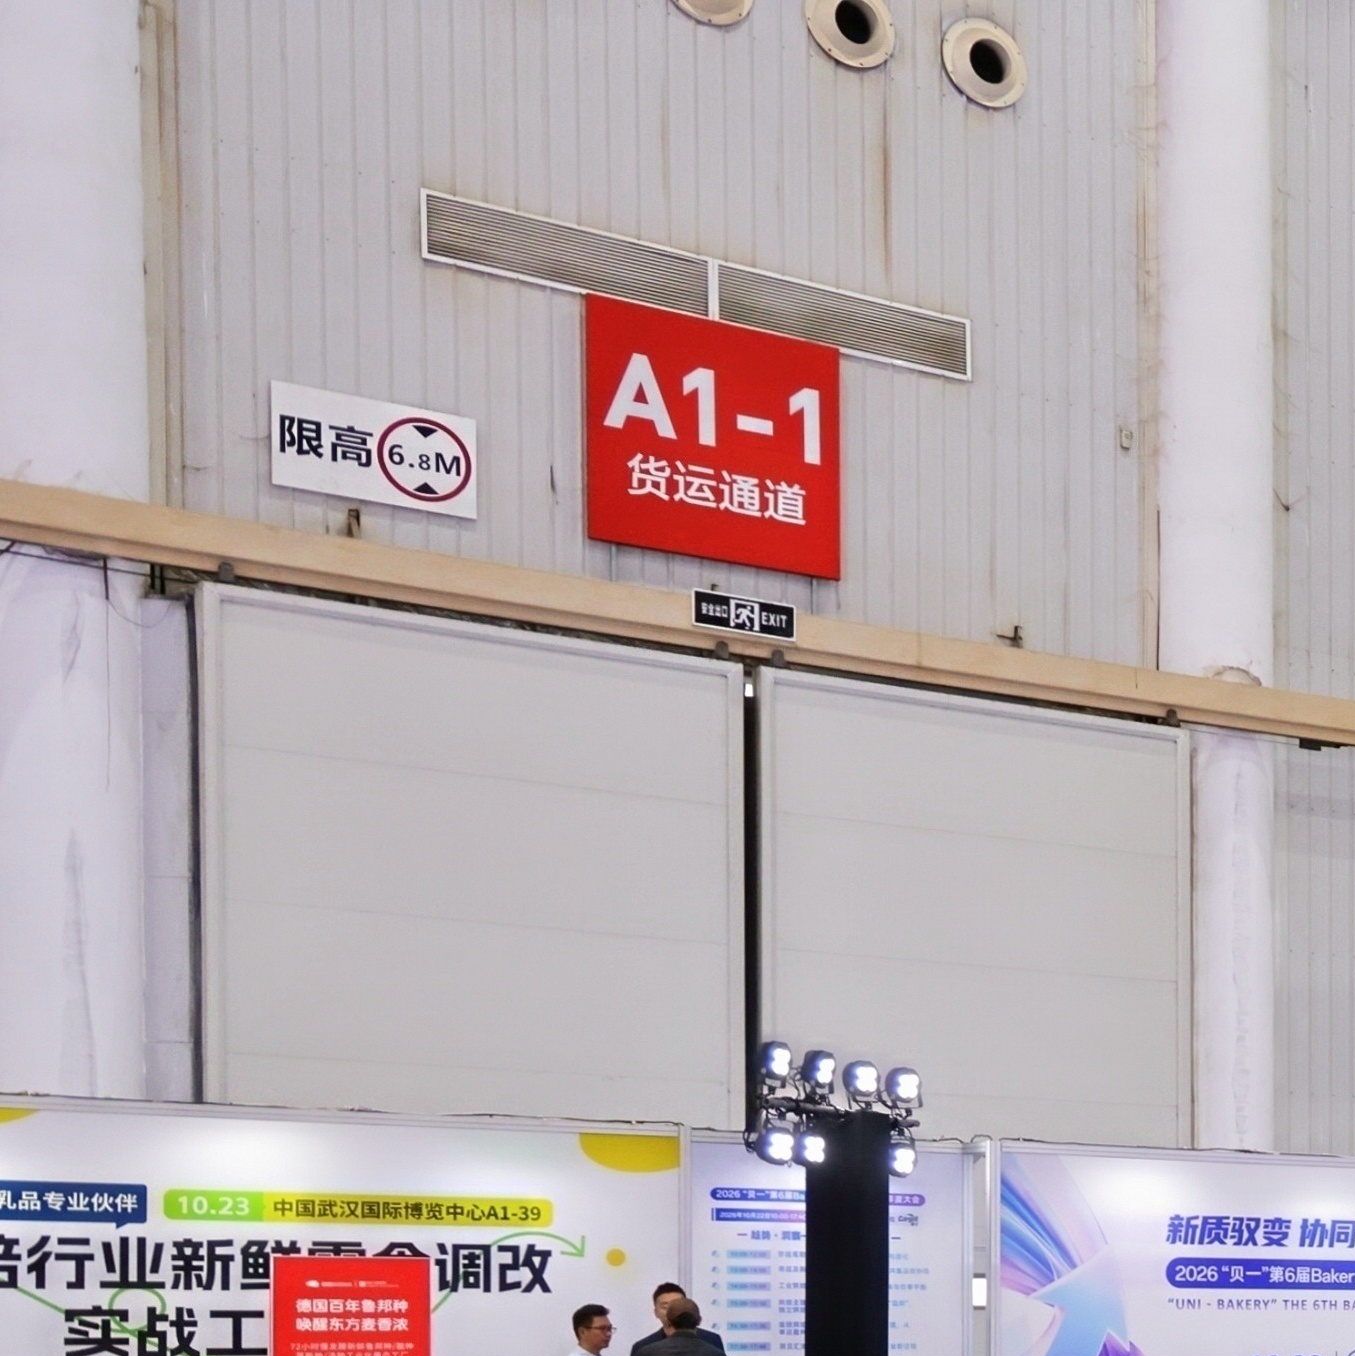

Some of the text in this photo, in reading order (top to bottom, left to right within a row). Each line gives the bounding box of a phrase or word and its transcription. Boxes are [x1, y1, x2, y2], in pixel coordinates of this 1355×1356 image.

[603, 352, 821, 466] A1-1
[279, 414, 461, 477] 限高 6.8M
[627, 452, 806, 526] 货运通道
[761, 611, 787, 628] EXIT
[178, 1196, 541, 1222] 10.23 中国武汉国际博览中心A1-39
[1166, 1215, 1291, 1248] 新质驭变
[1175, 1265, 1218, 1283] 2026
[1282, 1300, 1309, 1311] THE
[1313, 1300, 1338, 1311] 6TH
[296, 1317, 409, 1332] 唤醒东方麦香浓
